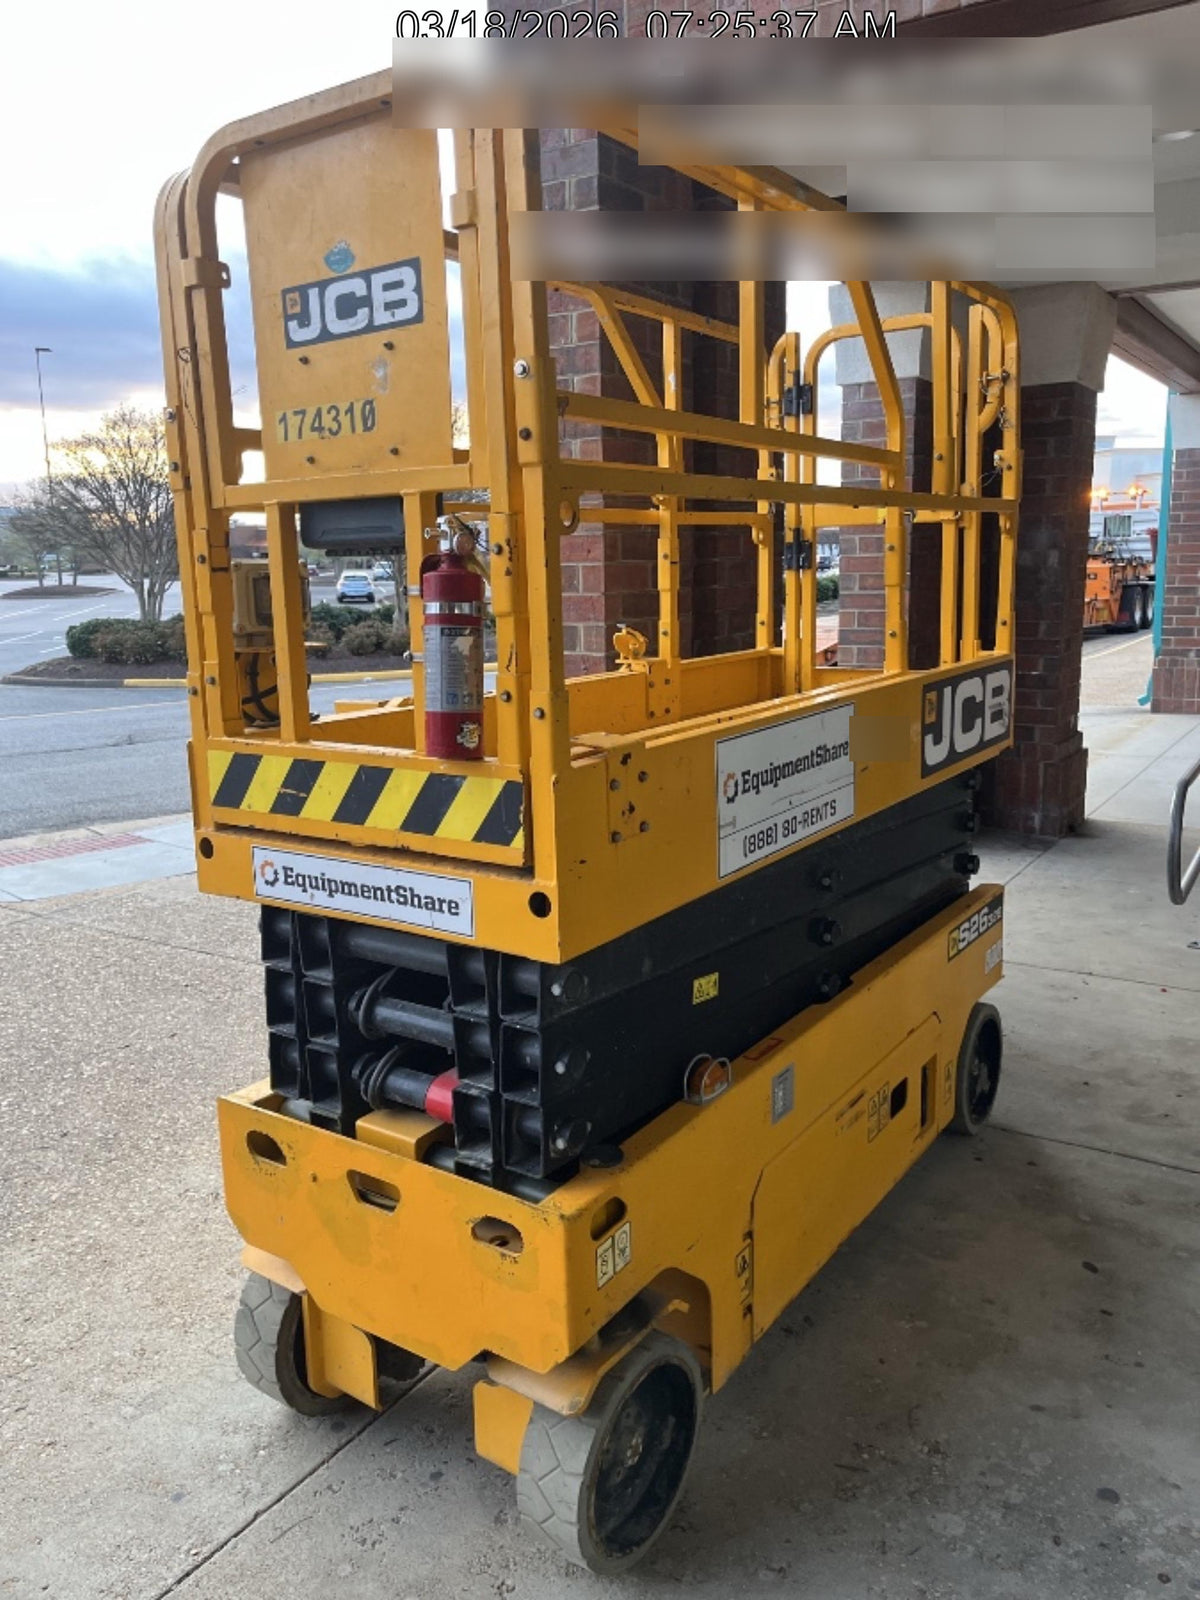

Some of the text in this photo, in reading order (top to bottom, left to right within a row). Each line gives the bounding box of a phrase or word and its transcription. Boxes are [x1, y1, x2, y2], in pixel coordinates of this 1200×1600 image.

[287, 266, 419, 342] JCB
[278, 399, 376, 441] 174310
[924, 669, 1010, 766] JCB
[741, 741, 849, 795] EquipmentShare
[743, 799, 837, 858] (888) 80-RENTS
[282, 866, 460, 916] EquipmentShare
